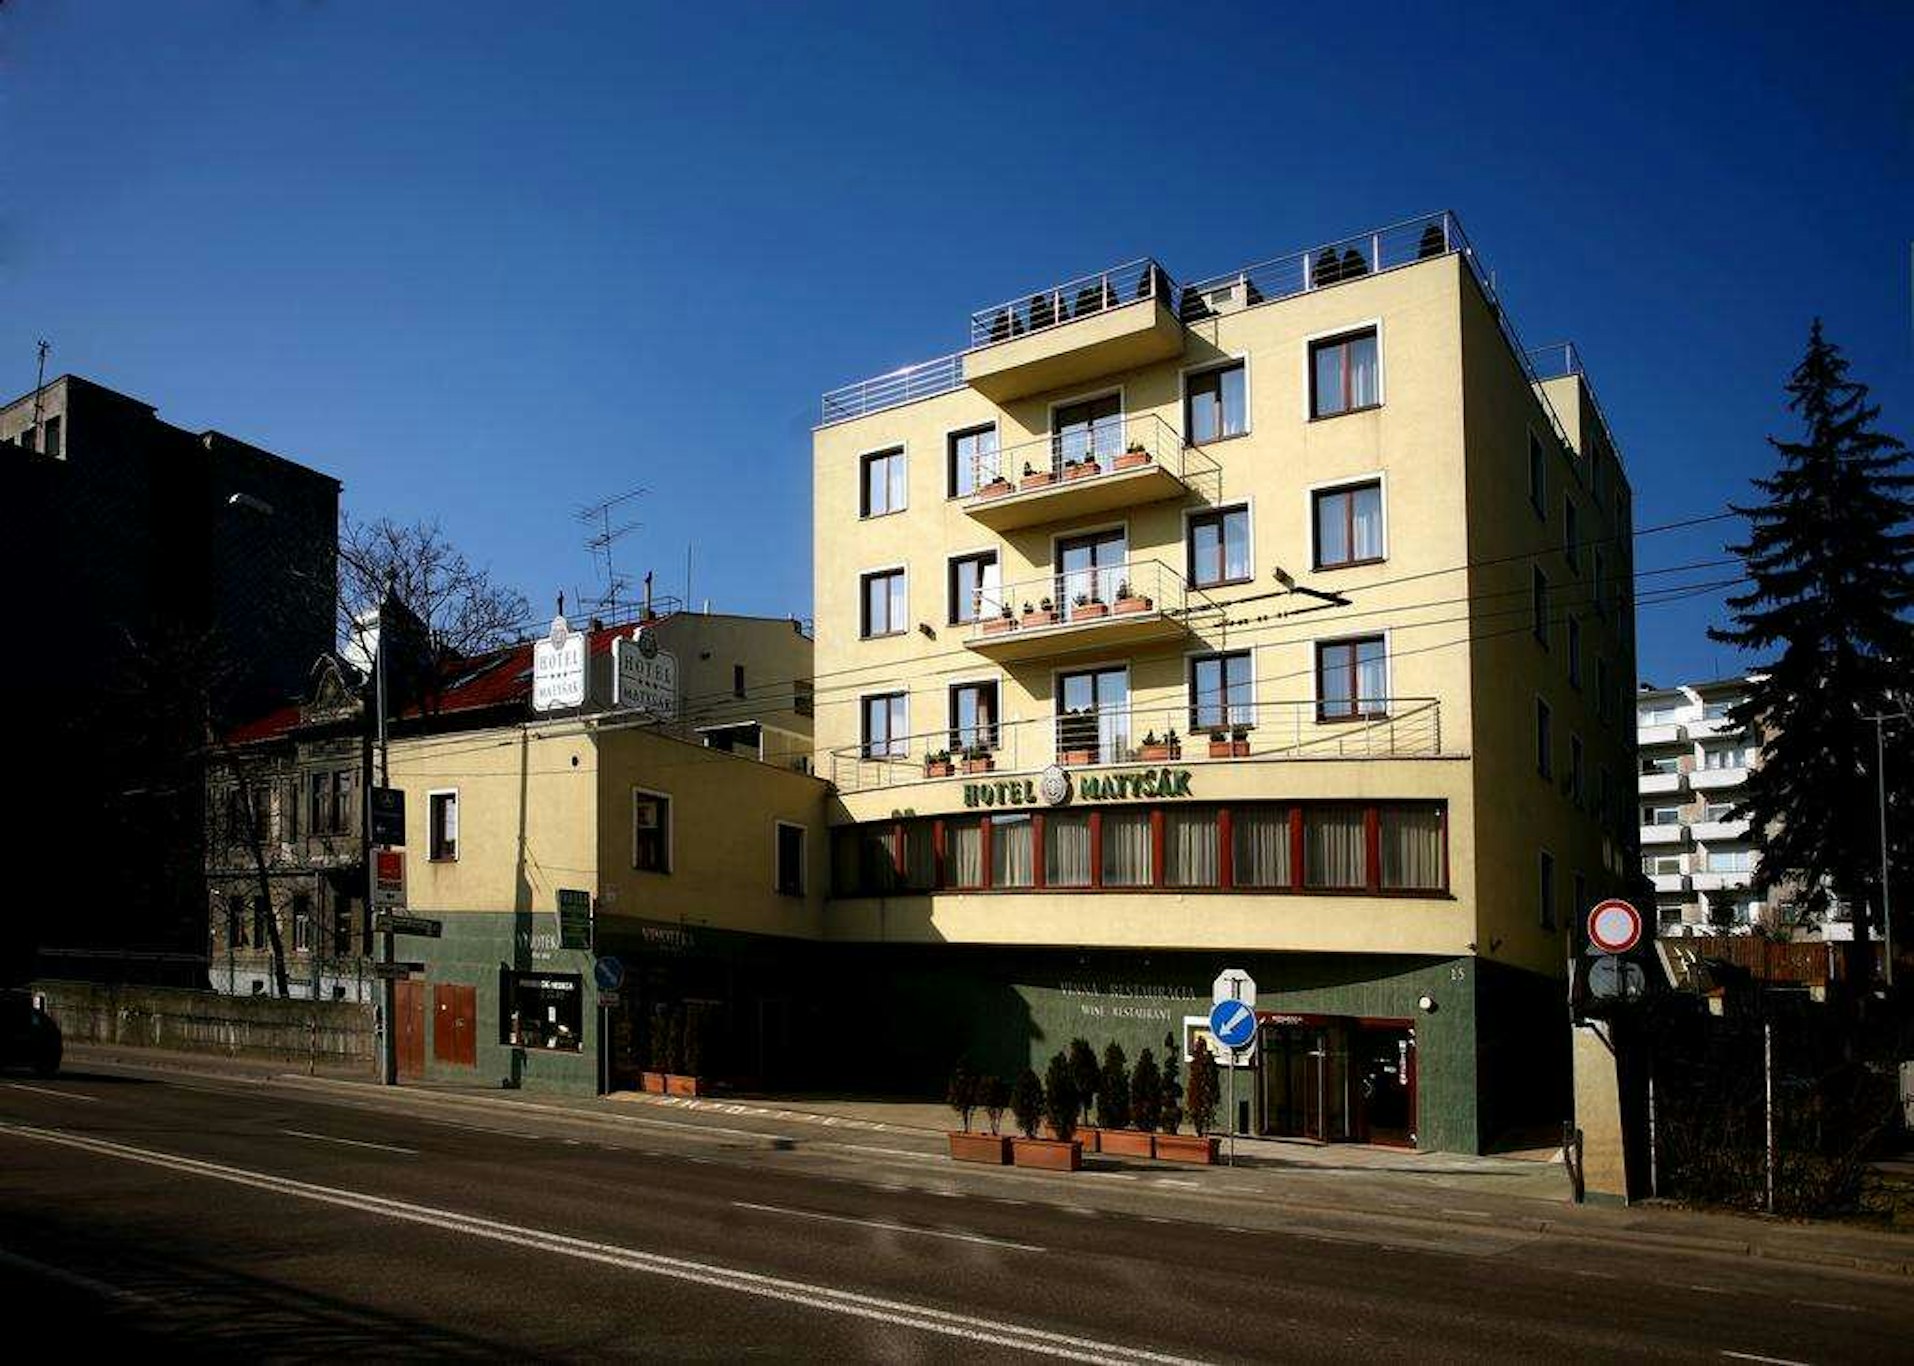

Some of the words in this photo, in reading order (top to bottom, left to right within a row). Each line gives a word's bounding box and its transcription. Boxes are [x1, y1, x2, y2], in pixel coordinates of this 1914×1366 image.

[539, 649, 578, 671] HOTEL
[624, 655, 672, 685] HOTEL
[964, 780, 1037, 807] HOTEL
